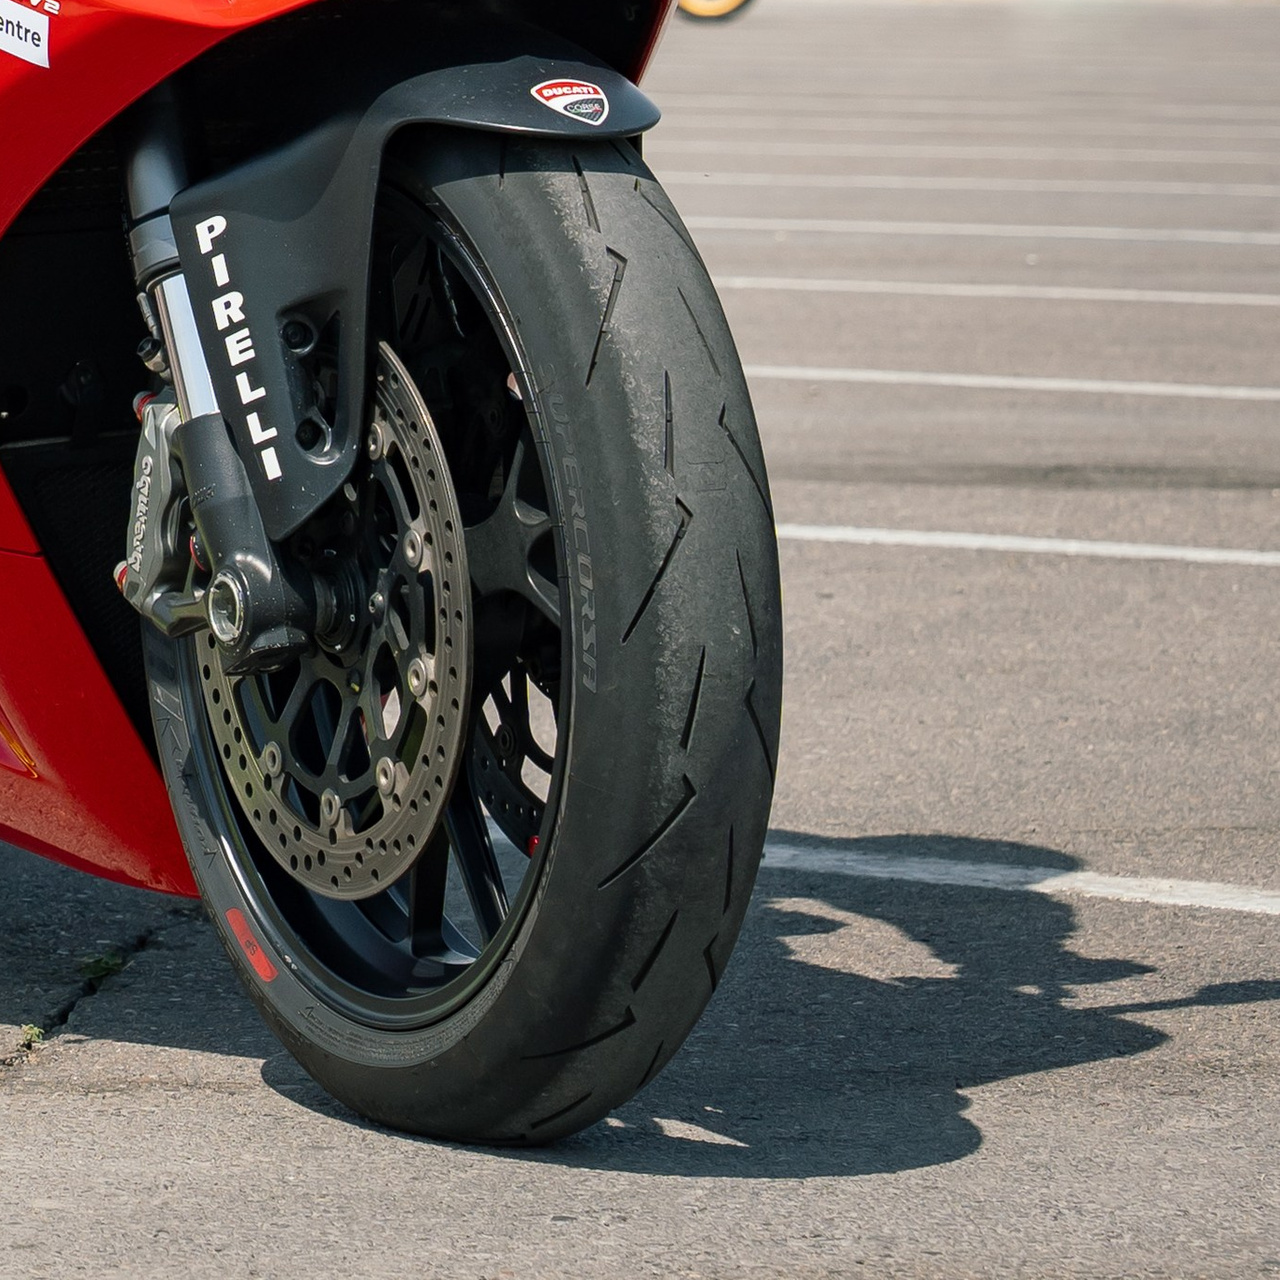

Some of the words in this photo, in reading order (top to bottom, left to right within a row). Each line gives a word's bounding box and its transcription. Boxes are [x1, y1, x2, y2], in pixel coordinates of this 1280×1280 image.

[541, 86, 595, 98] DUCATI
[195, 215, 283, 480] PIRELLI
[127, 454, 153, 573] brembo
